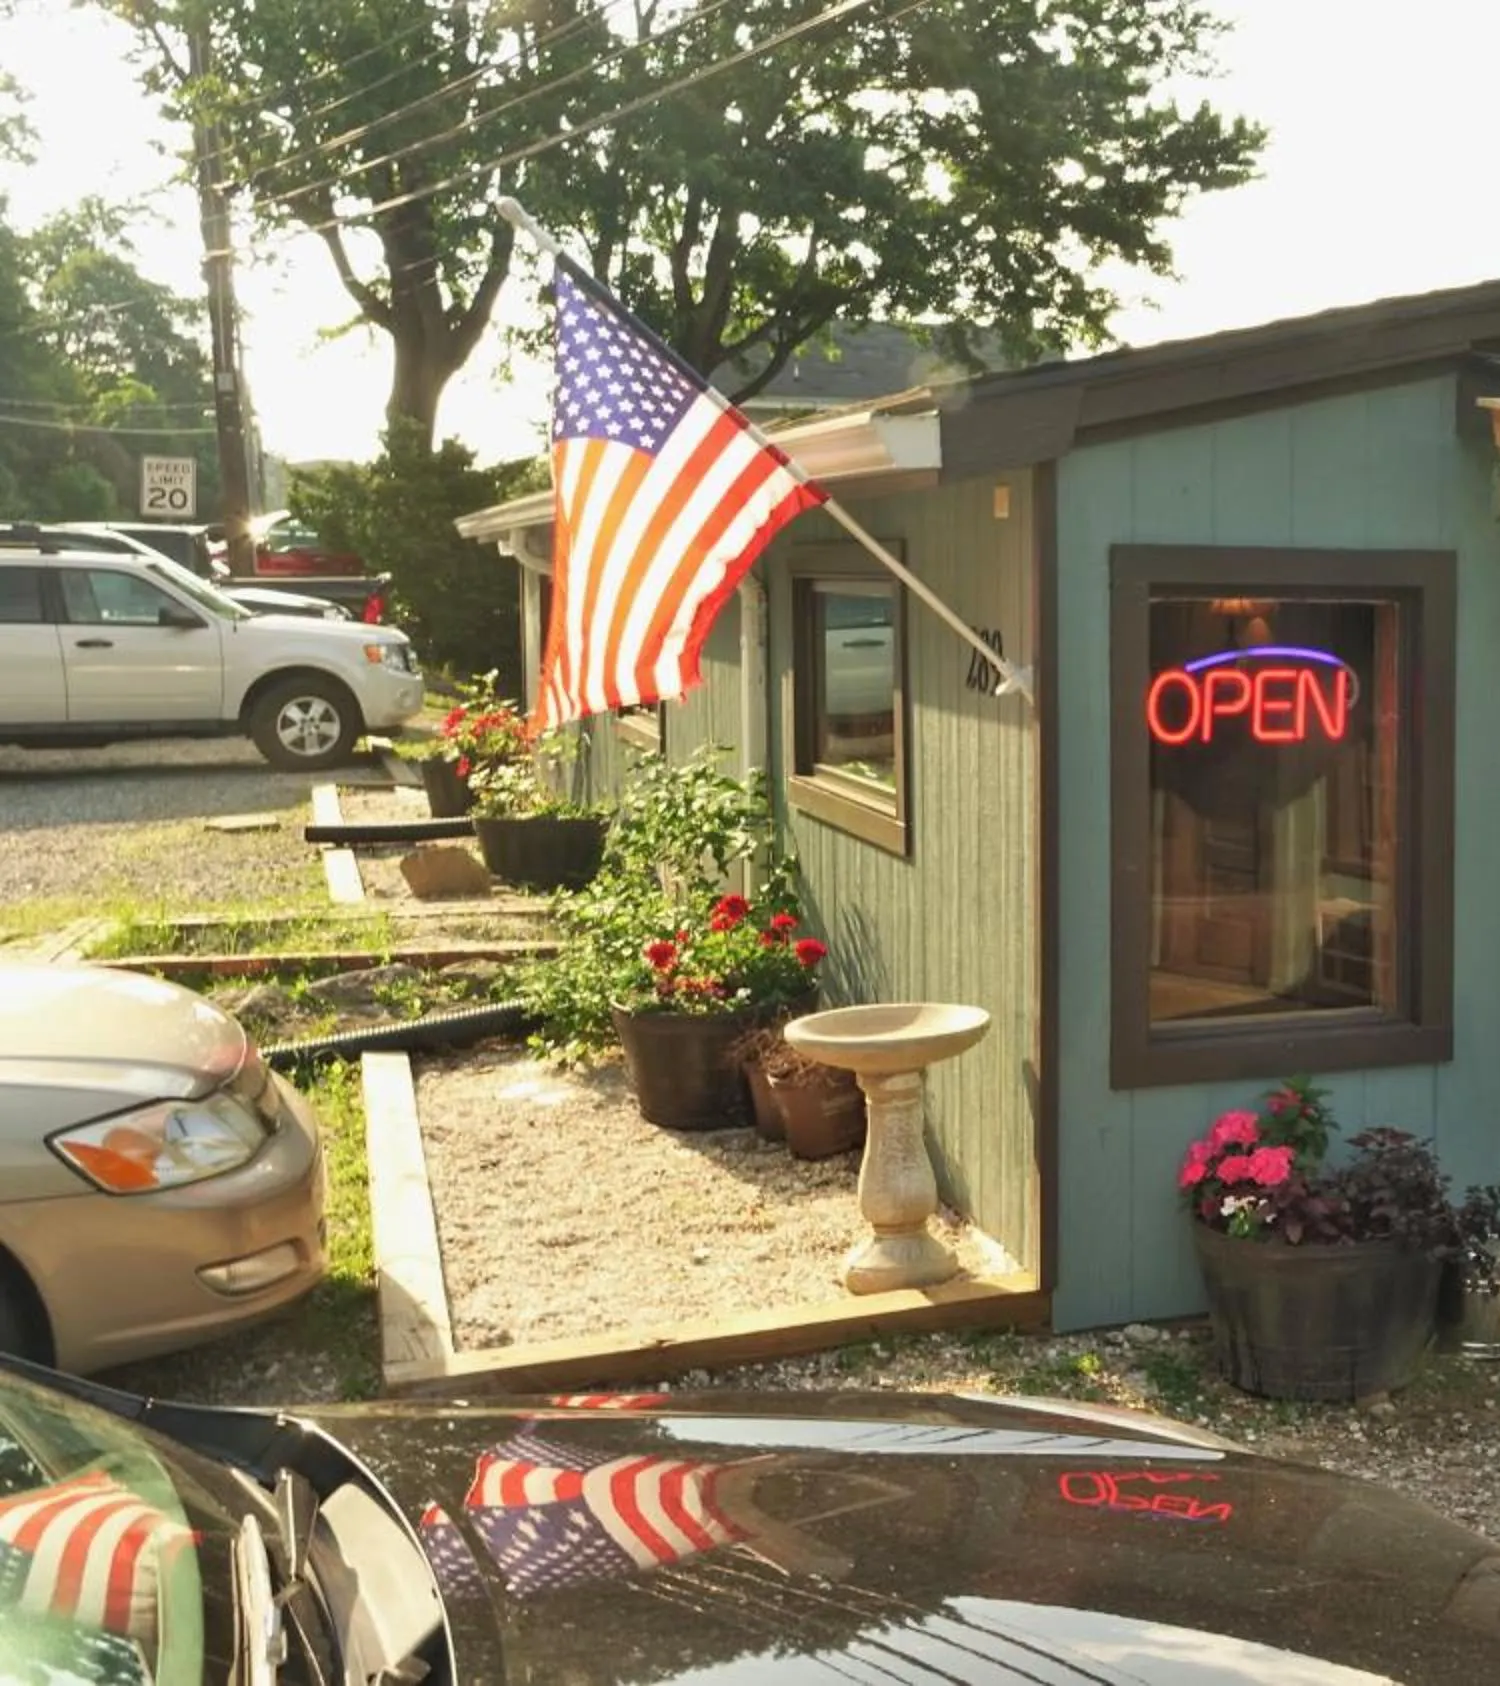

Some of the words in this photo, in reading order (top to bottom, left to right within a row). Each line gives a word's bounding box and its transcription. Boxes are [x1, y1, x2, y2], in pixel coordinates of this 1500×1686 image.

[147, 463, 190, 474] SPEED
[150, 476, 183, 485] LIMIT
[148, 487, 187, 510] 20
[1147, 667, 1347, 746] OPEN
